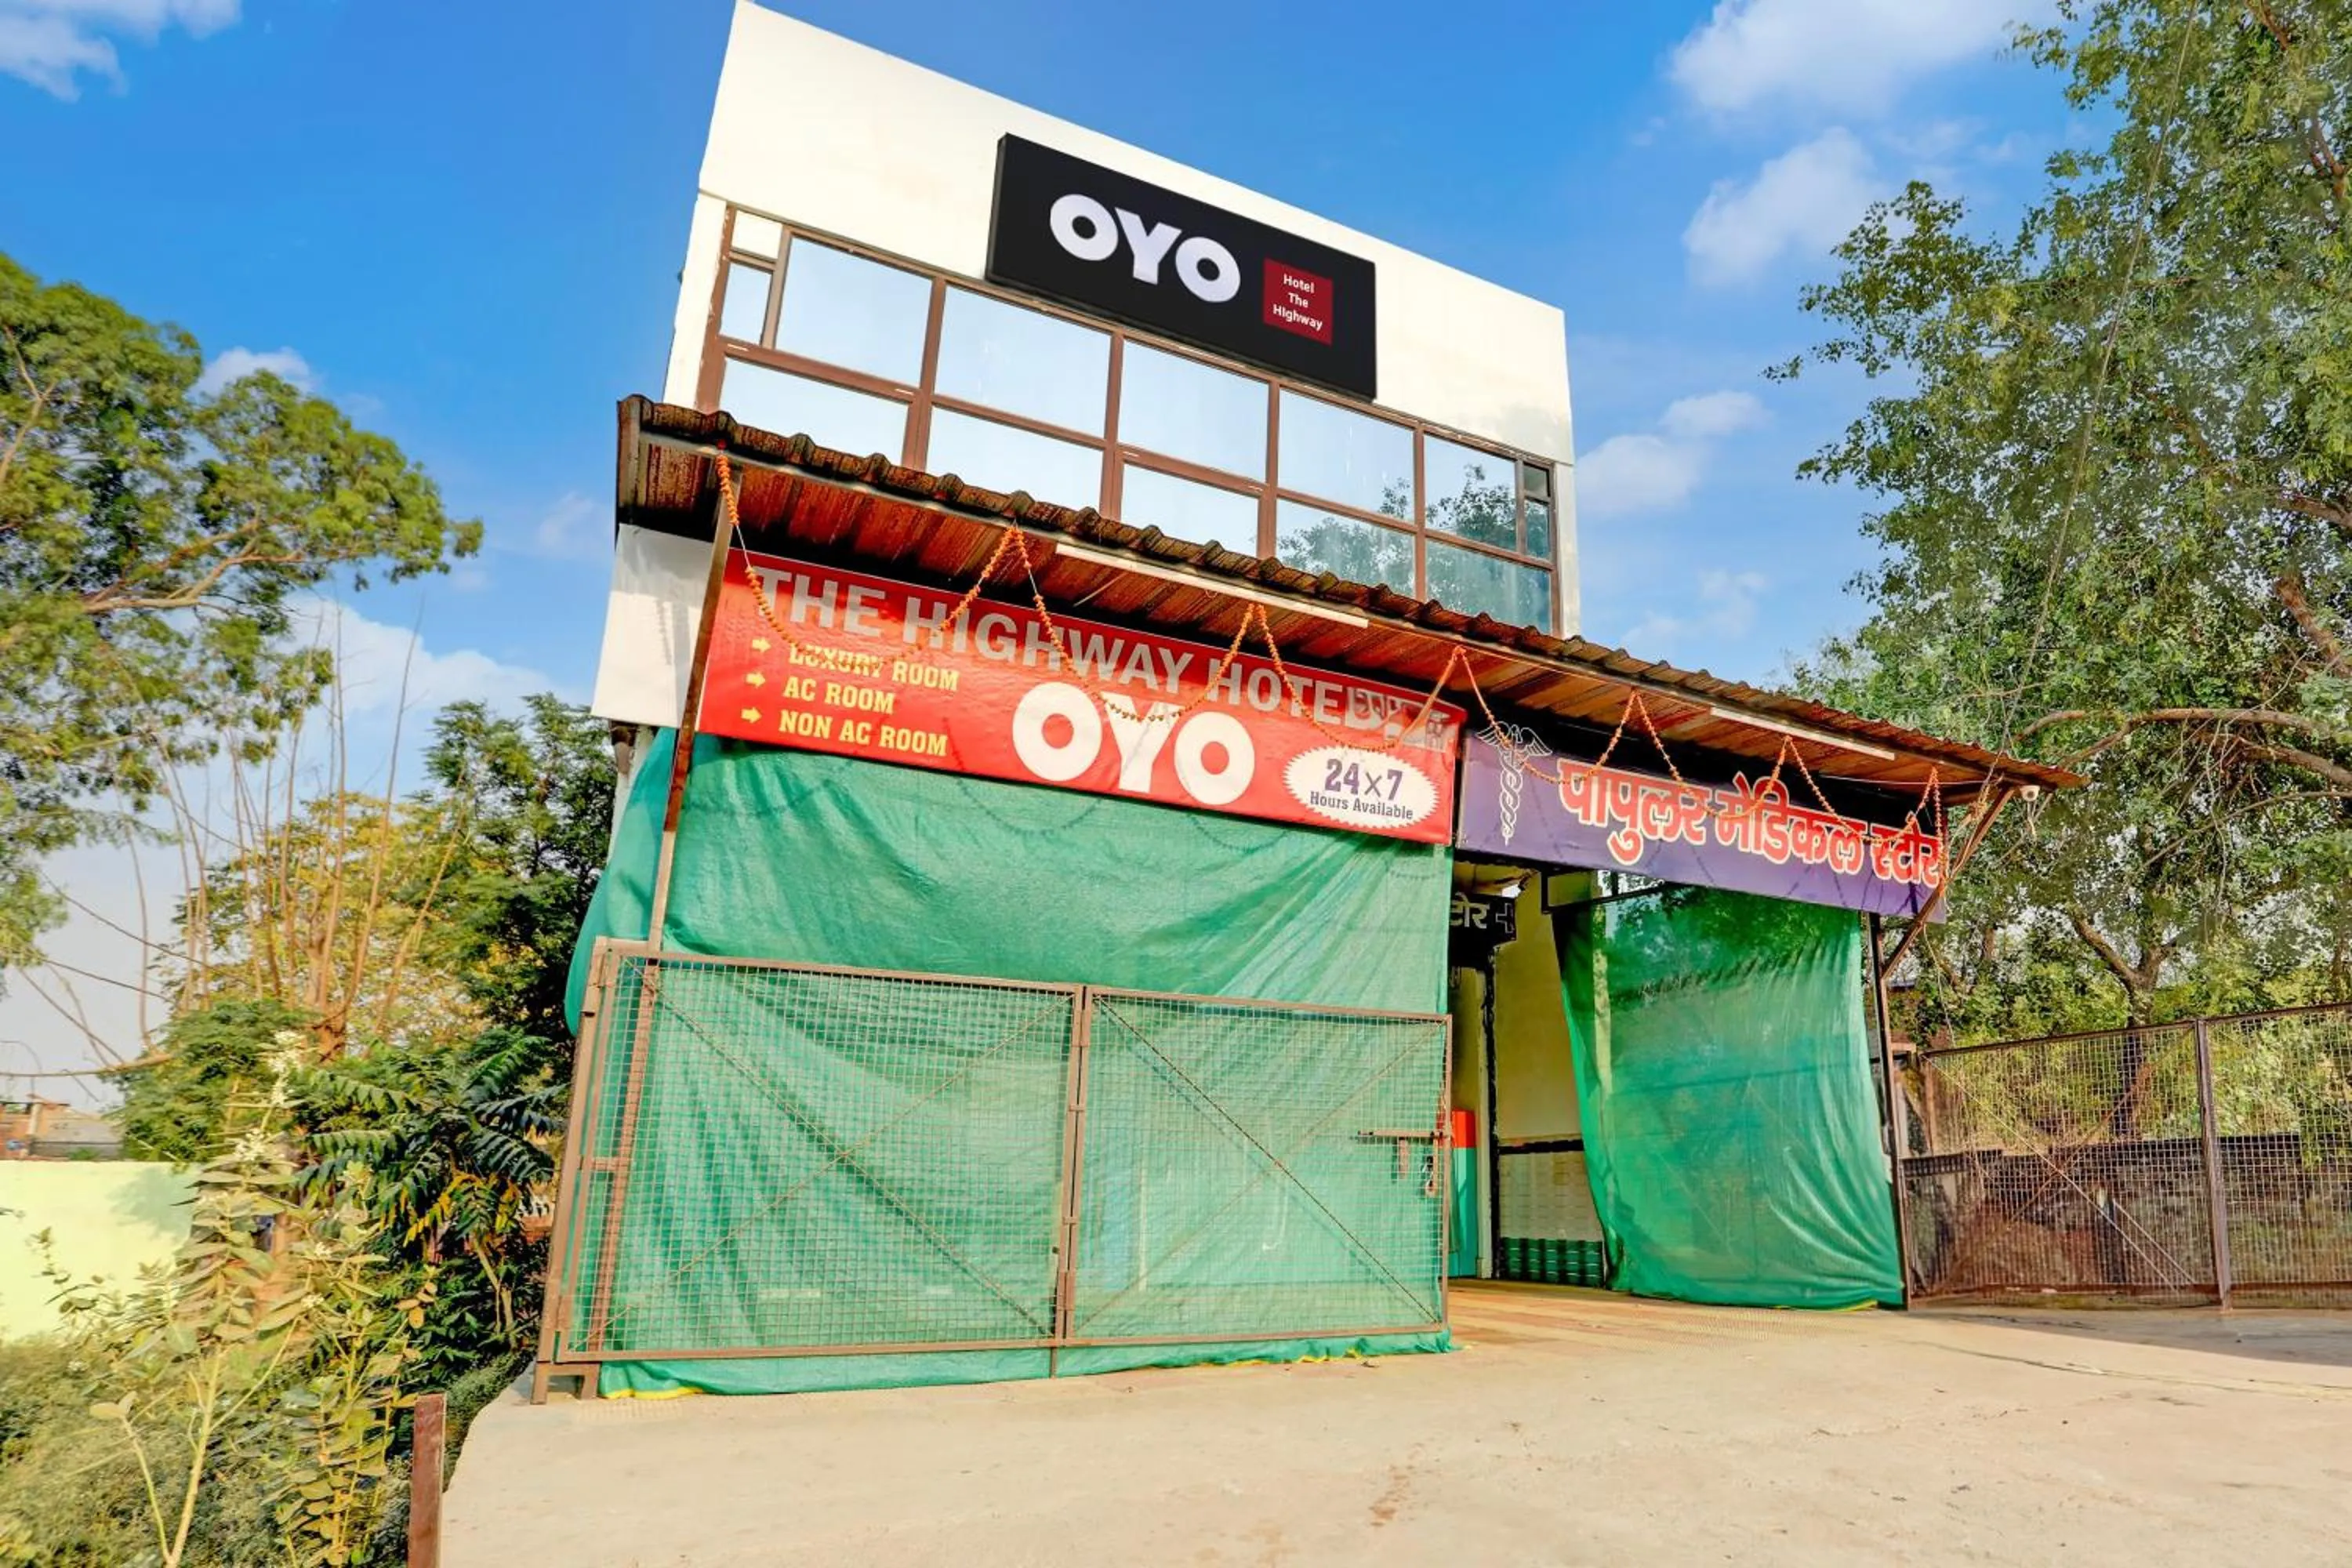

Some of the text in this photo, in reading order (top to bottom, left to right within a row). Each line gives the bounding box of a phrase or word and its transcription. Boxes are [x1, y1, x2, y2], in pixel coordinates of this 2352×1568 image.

[1050, 194, 1241, 303] OYO
[1283, 273, 1315, 294] Hotel
[1288, 292, 1309, 308] The
[1272, 303, 1323, 332] Highway
[750, 565, 886, 637] THE
[902, 597, 1194, 695] HIGHWAY
[789, 643, 960, 691] LUXURY ROOM
[782, 676, 896, 715] AC ROOM
[779, 709, 948, 757] NON AC ROOM
[1012, 682, 1255, 805] OYO
[1310, 791, 1414, 819] Hours Available
[1557, 757, 1940, 888] पापुलर मेडिकल स्टोर
[1450, 891, 1490, 929] टोर
